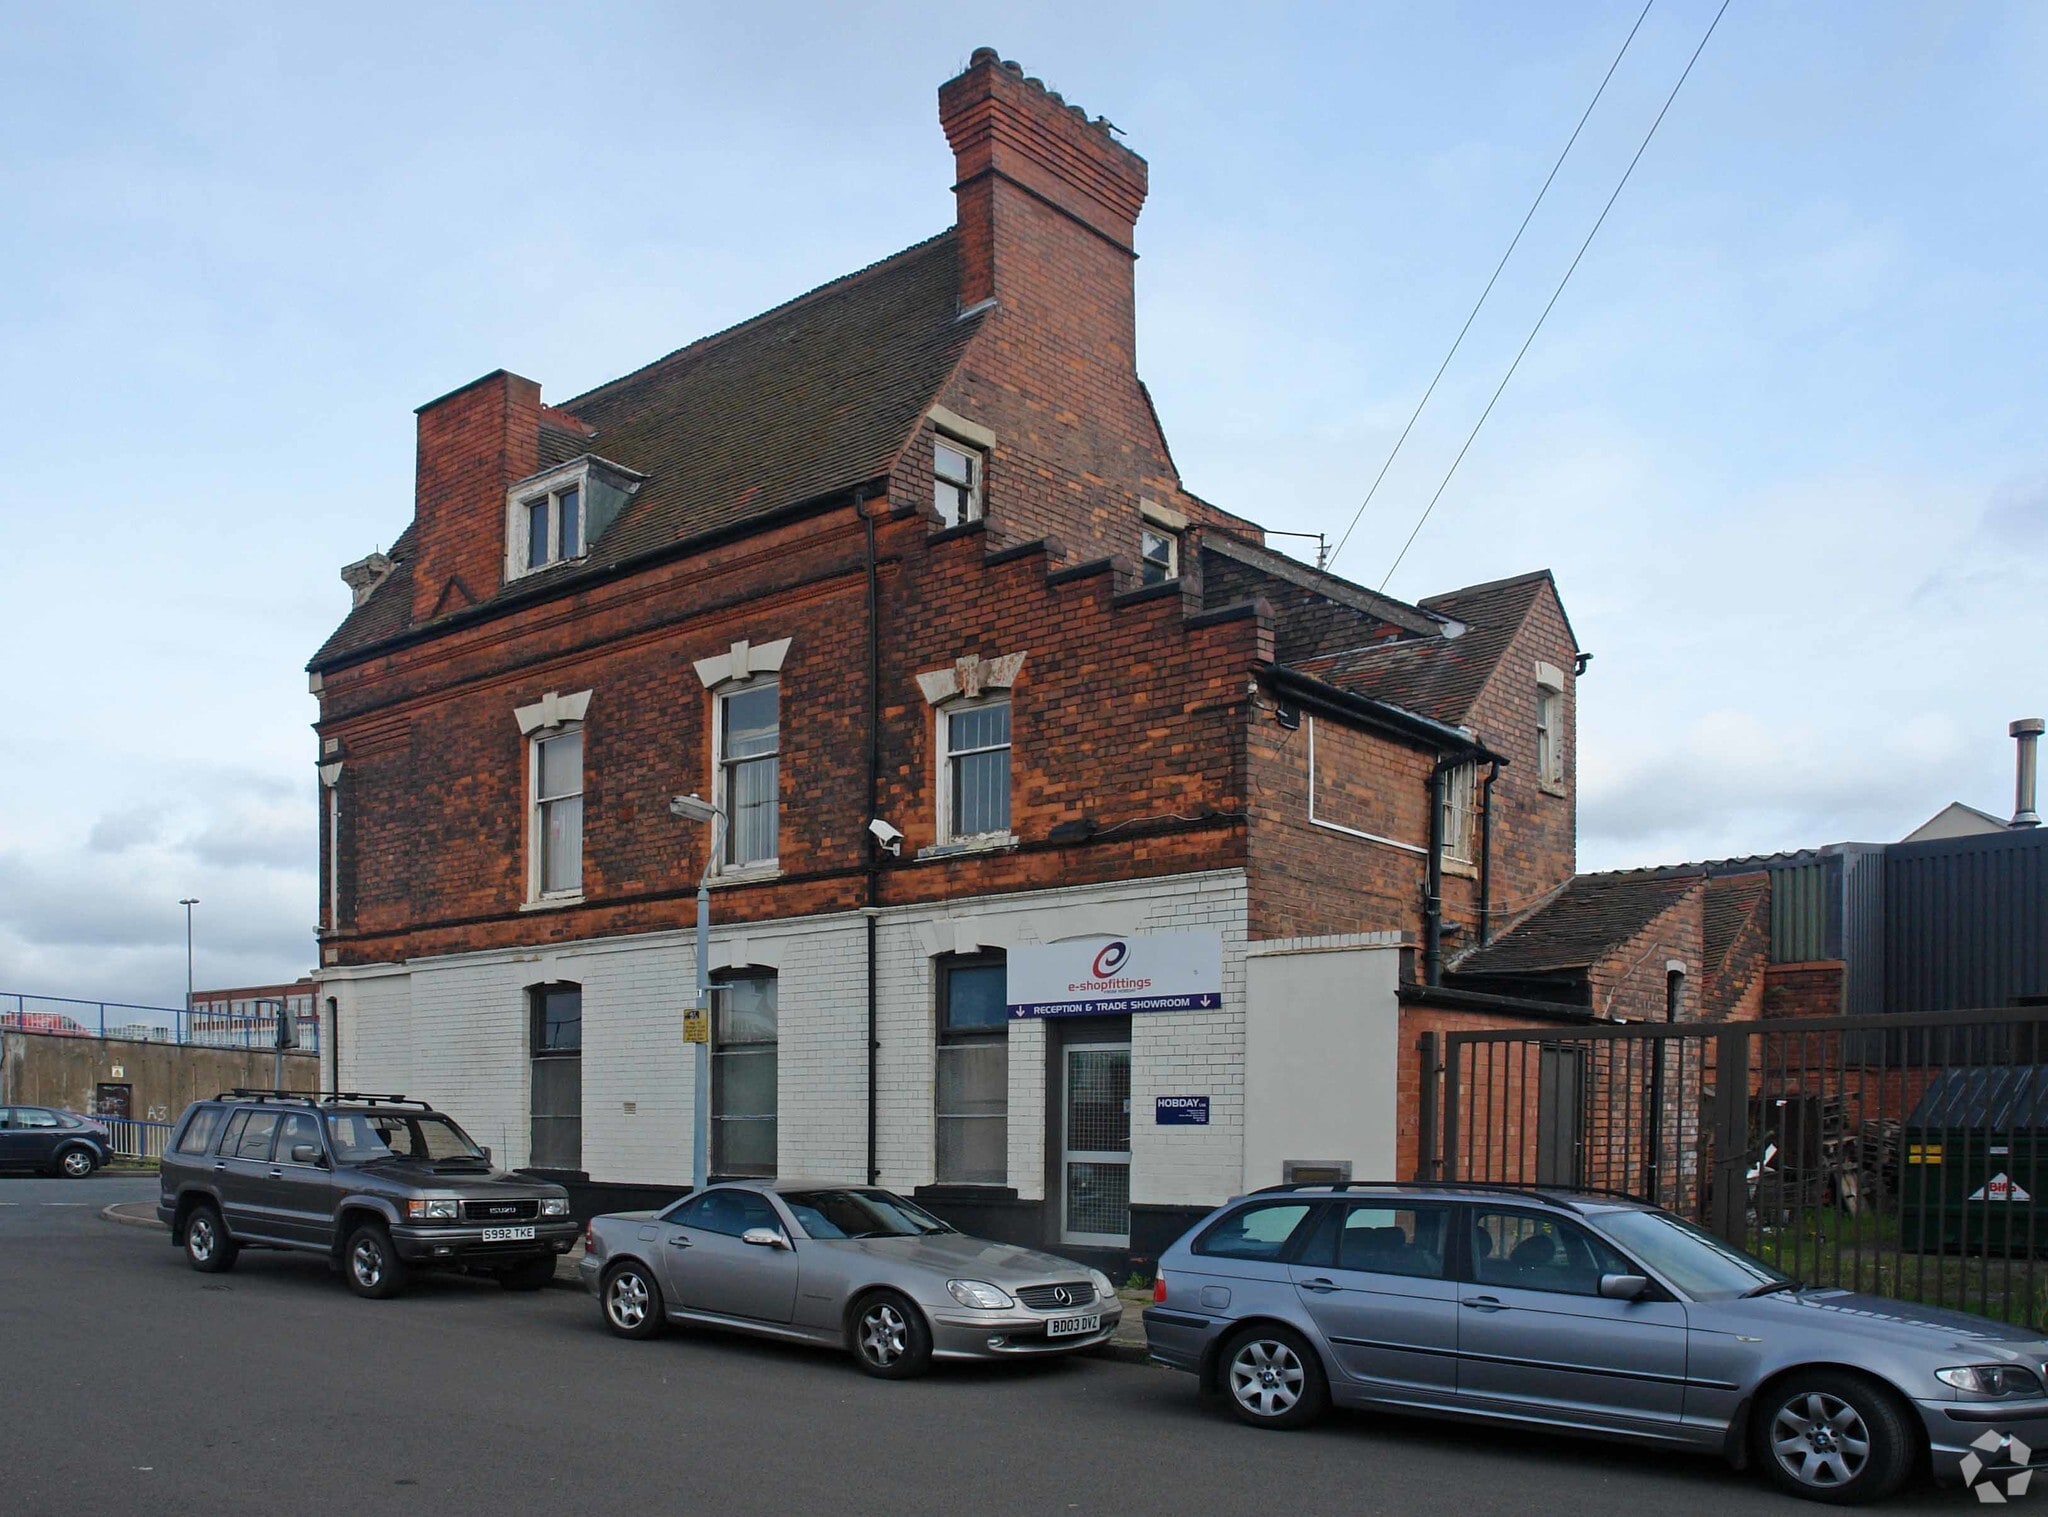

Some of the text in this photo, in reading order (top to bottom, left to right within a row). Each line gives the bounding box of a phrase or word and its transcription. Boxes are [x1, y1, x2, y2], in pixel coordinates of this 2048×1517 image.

[1068, 977, 1152, 992] e-shopfittings
[1033, 998, 1190, 1015] RECEPTION & TRADE SHOWROOM
[1157, 1098, 1199, 1108] HOBDAY
[147, 1104, 168, 1121] A3
[1989, 1182, 2017, 1192] Bifa
[484, 1227, 534, 1240] S992 TKE
[1053, 1315, 1098, 1334] BD03 DVZ
